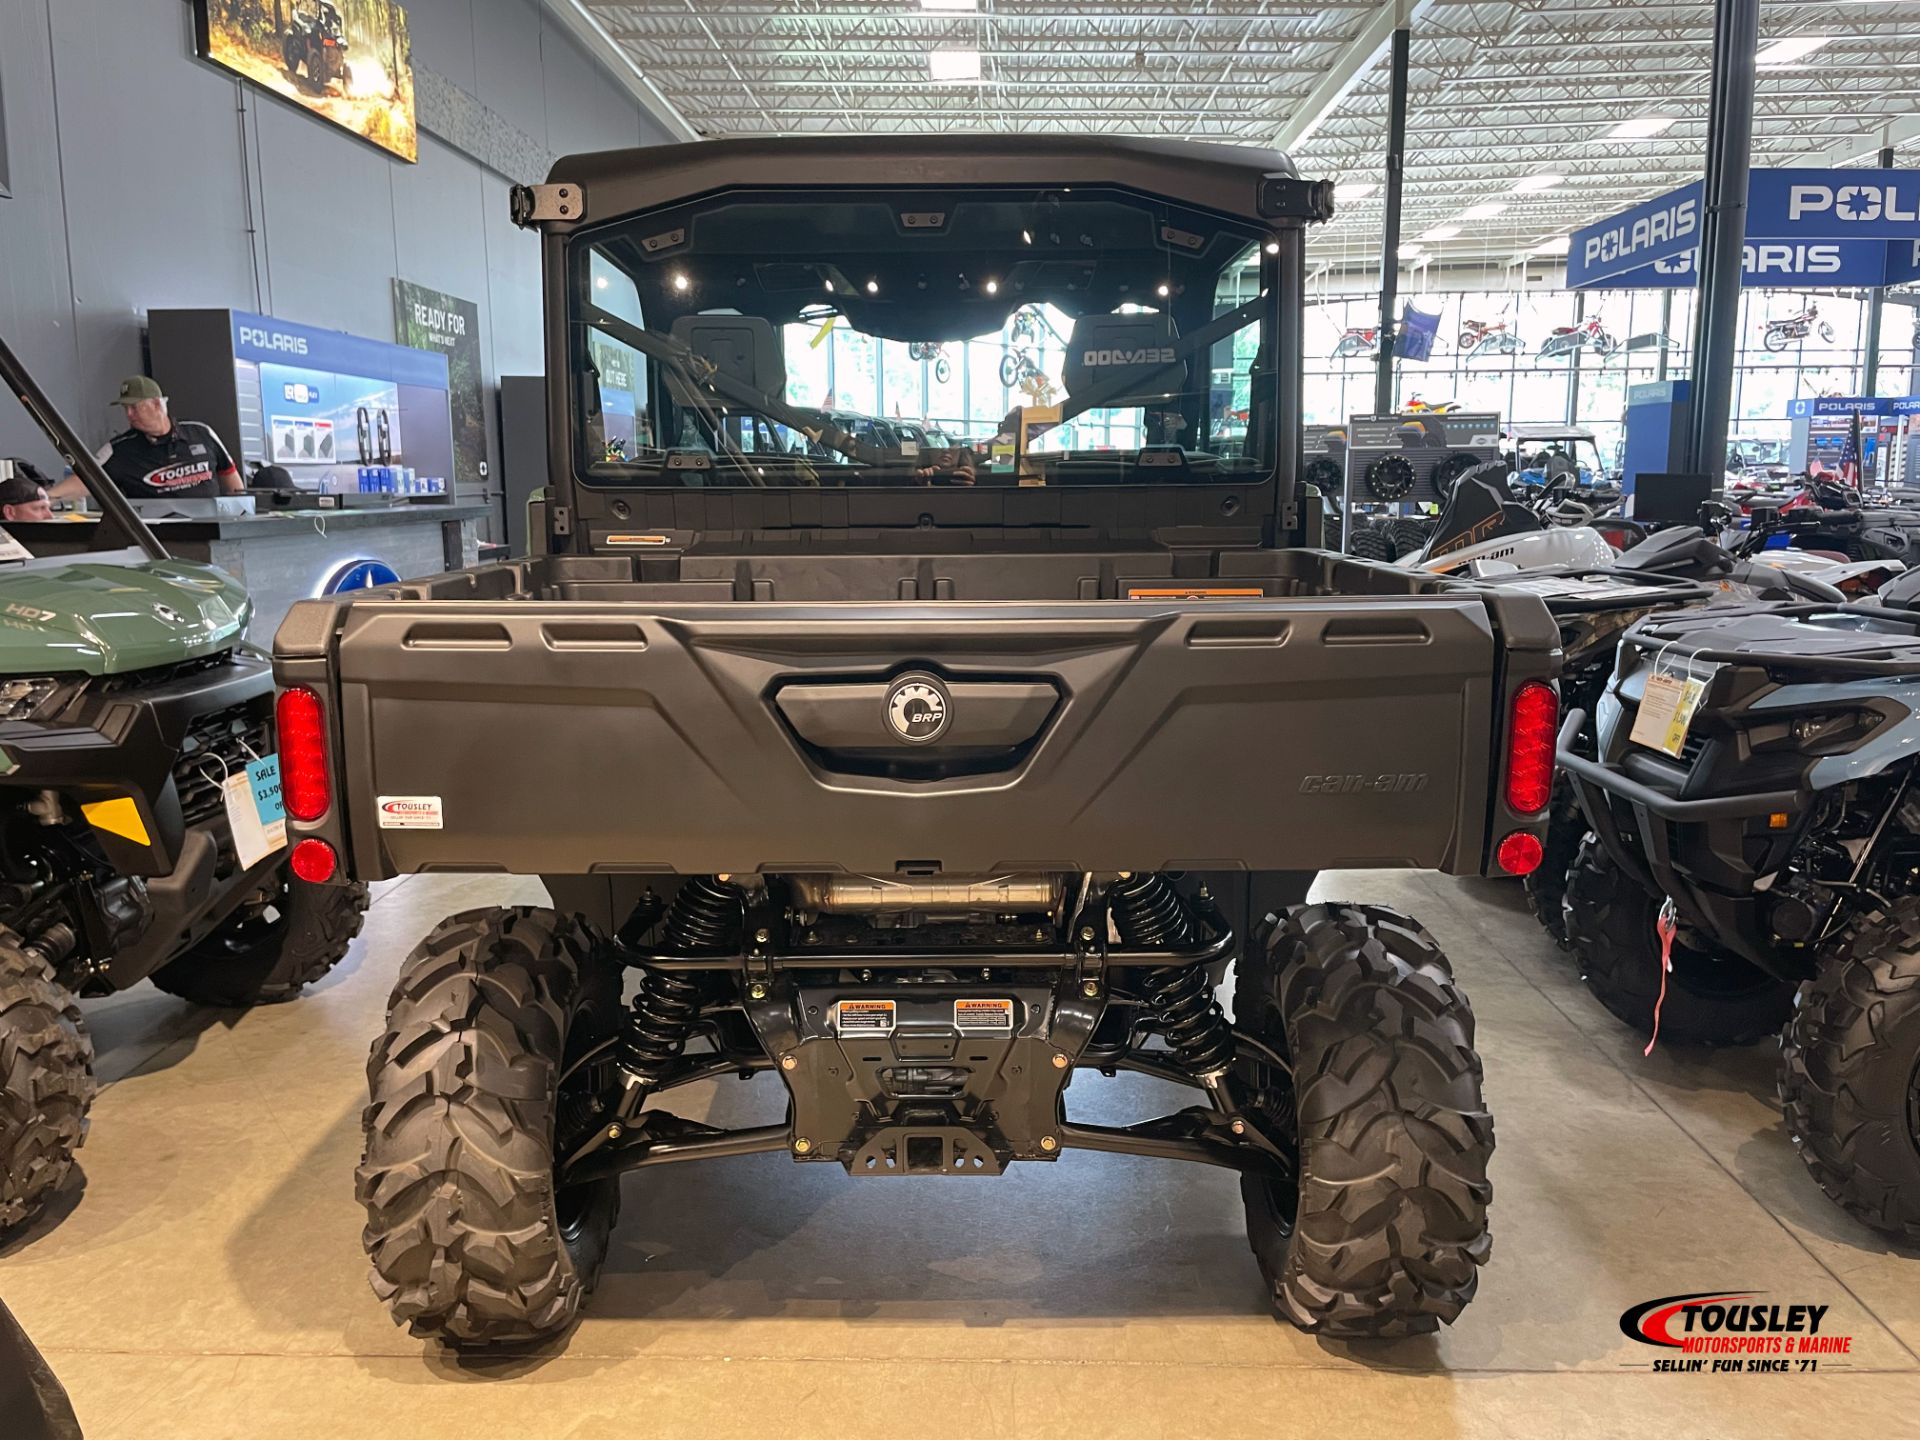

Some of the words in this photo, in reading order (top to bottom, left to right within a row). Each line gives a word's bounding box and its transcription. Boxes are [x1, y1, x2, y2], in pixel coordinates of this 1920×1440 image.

[1585, 199, 1696, 269] POLARIS
[414, 303, 446, 331] READY
[447, 313, 466, 336] FOR
[239, 326, 308, 355] POLARIS
[1818, 402, 1876, 411] POLARIS
[158, 460, 209, 482] TOUSLEY
[5, 603, 57, 622] HD7
[911, 713, 943, 723] BRP
[255, 765, 277, 782] SALE
[1298, 773, 1430, 794] can-am
[397, 803, 432, 811] TOUSLEY
